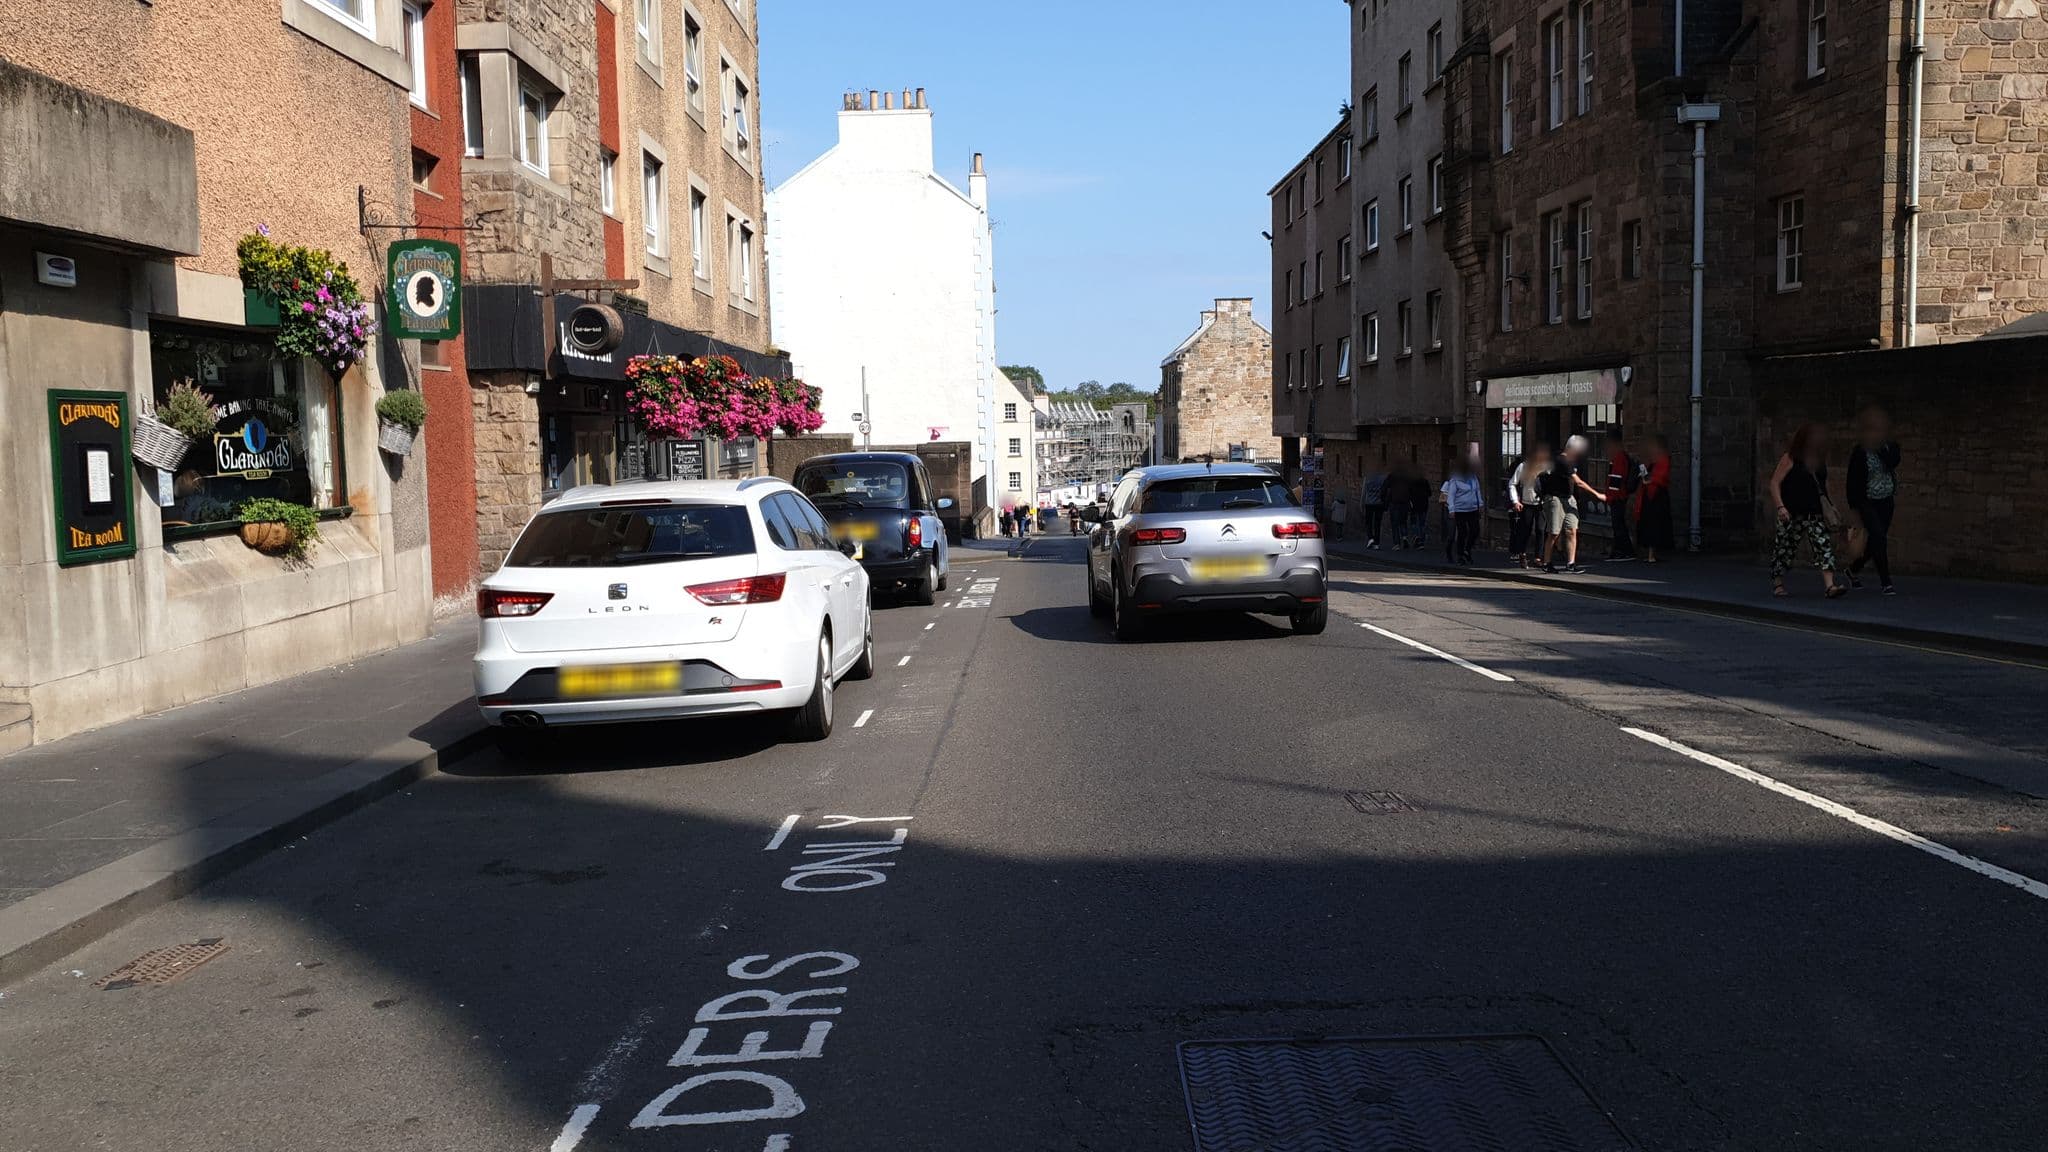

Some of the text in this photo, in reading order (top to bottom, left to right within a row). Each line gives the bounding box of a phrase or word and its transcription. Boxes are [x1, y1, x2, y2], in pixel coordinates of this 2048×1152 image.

[1505, 381, 1593, 397] delicious scottish hog roasts
[60, 403, 120, 429] CLARINDA'S
[219, 437, 290, 470] CLARINDA'S
[70, 522, 123, 548] TEA ROOM
[588, 605, 649, 614] LEON
[629, 815, 914, 1152] DERS ONLY
